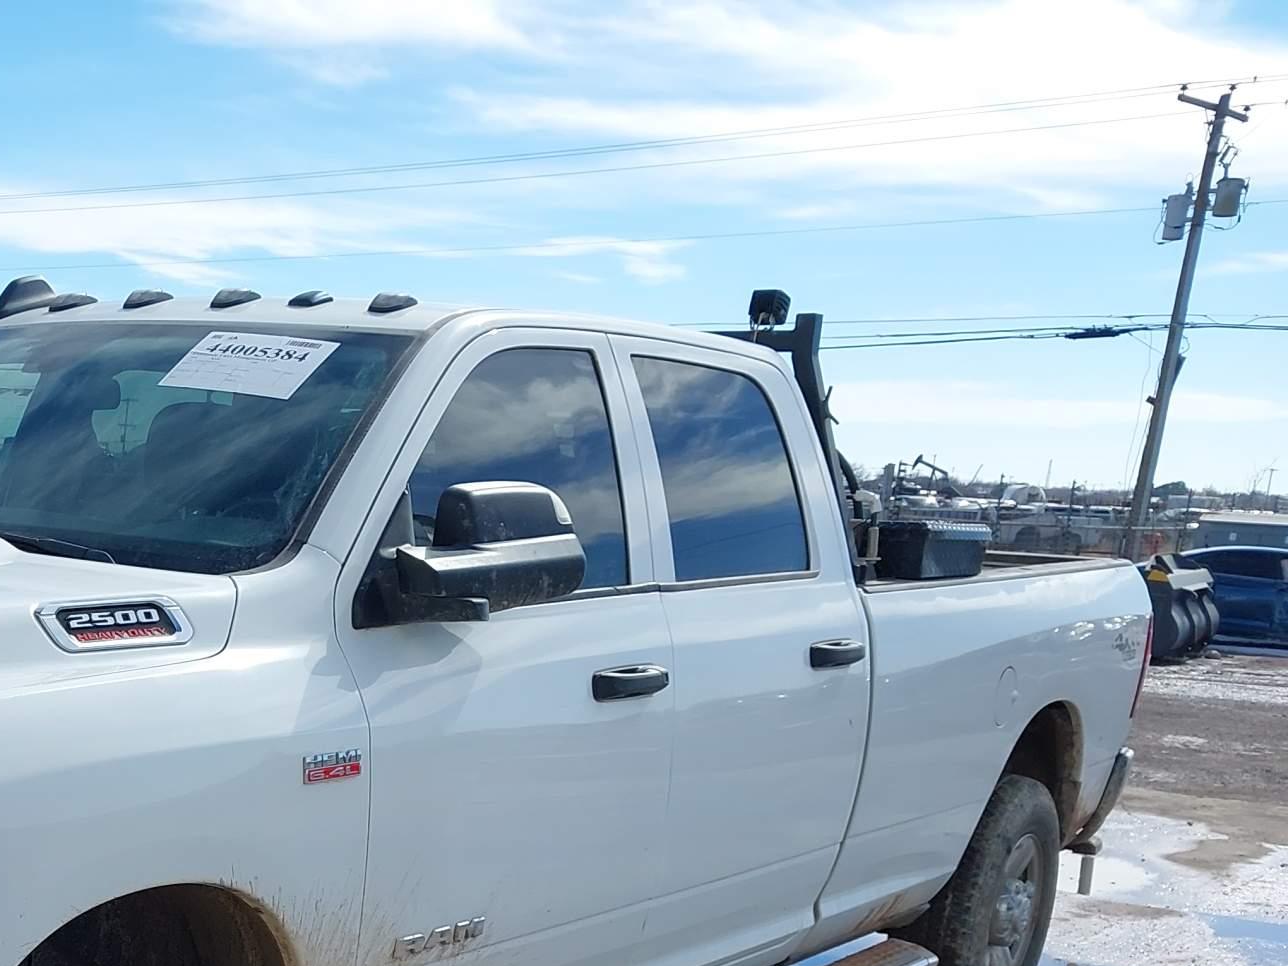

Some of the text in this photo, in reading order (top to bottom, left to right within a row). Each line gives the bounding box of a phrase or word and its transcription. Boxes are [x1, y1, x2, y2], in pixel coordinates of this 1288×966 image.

[206, 343, 311, 362] 44005384
[65, 608, 160, 629] 2500
[127, 627, 167, 639] DUTY
[303, 748, 361, 769] HEMI
[310, 762, 360, 781] 6.4L
